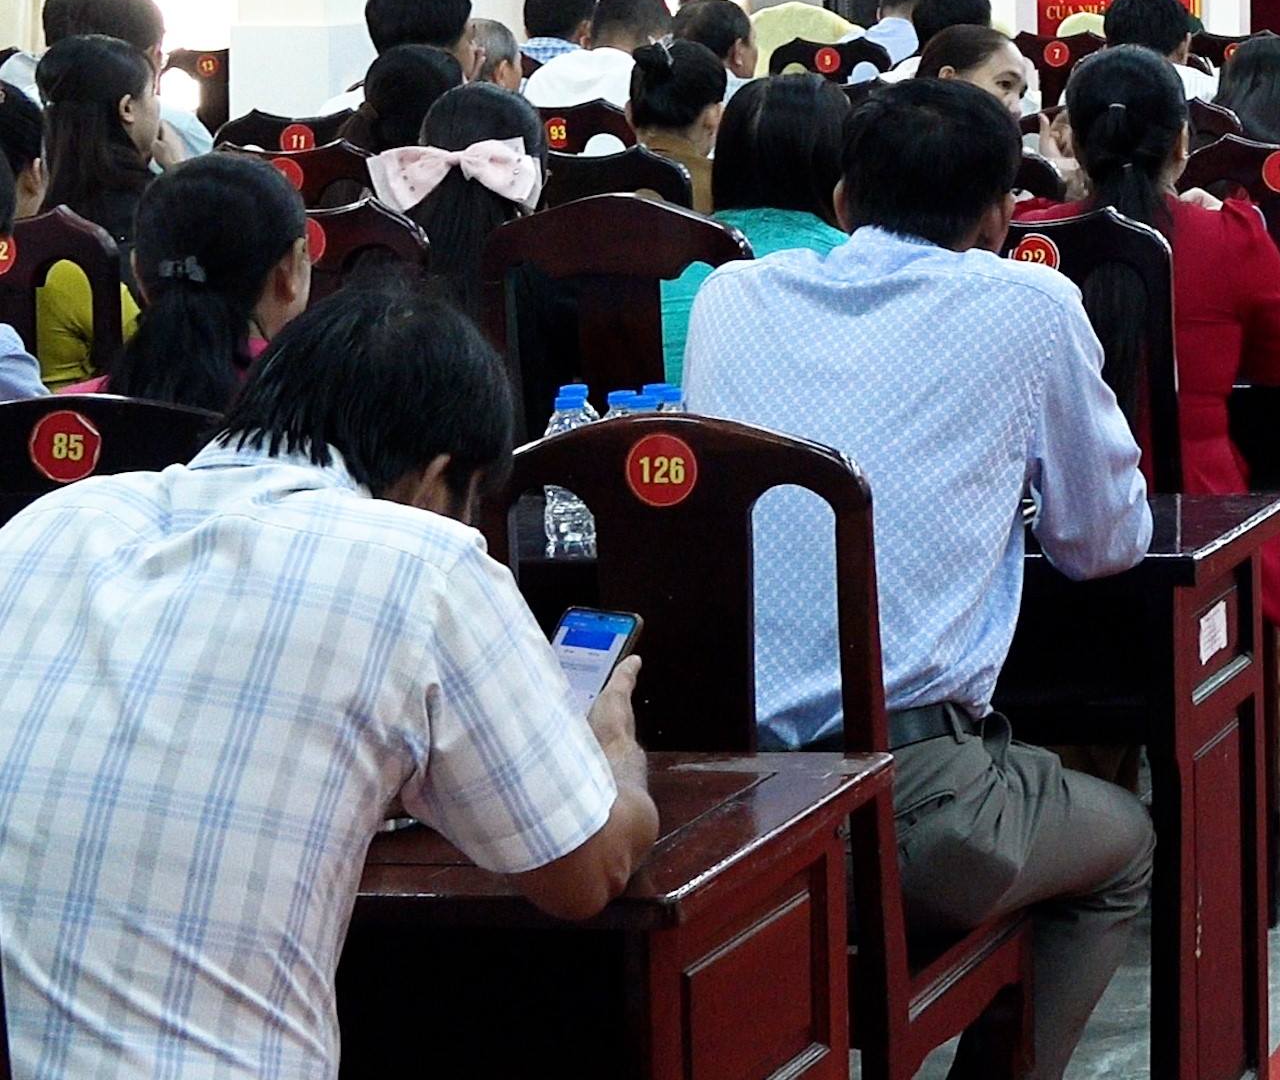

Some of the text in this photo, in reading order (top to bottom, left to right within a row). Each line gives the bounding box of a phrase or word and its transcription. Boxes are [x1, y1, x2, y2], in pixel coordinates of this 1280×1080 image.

[291, 134, 306, 150] 11
[549, 125, 567, 140] 93
[52, 432, 84, 461] 85
[639, 456, 685, 484] 126
